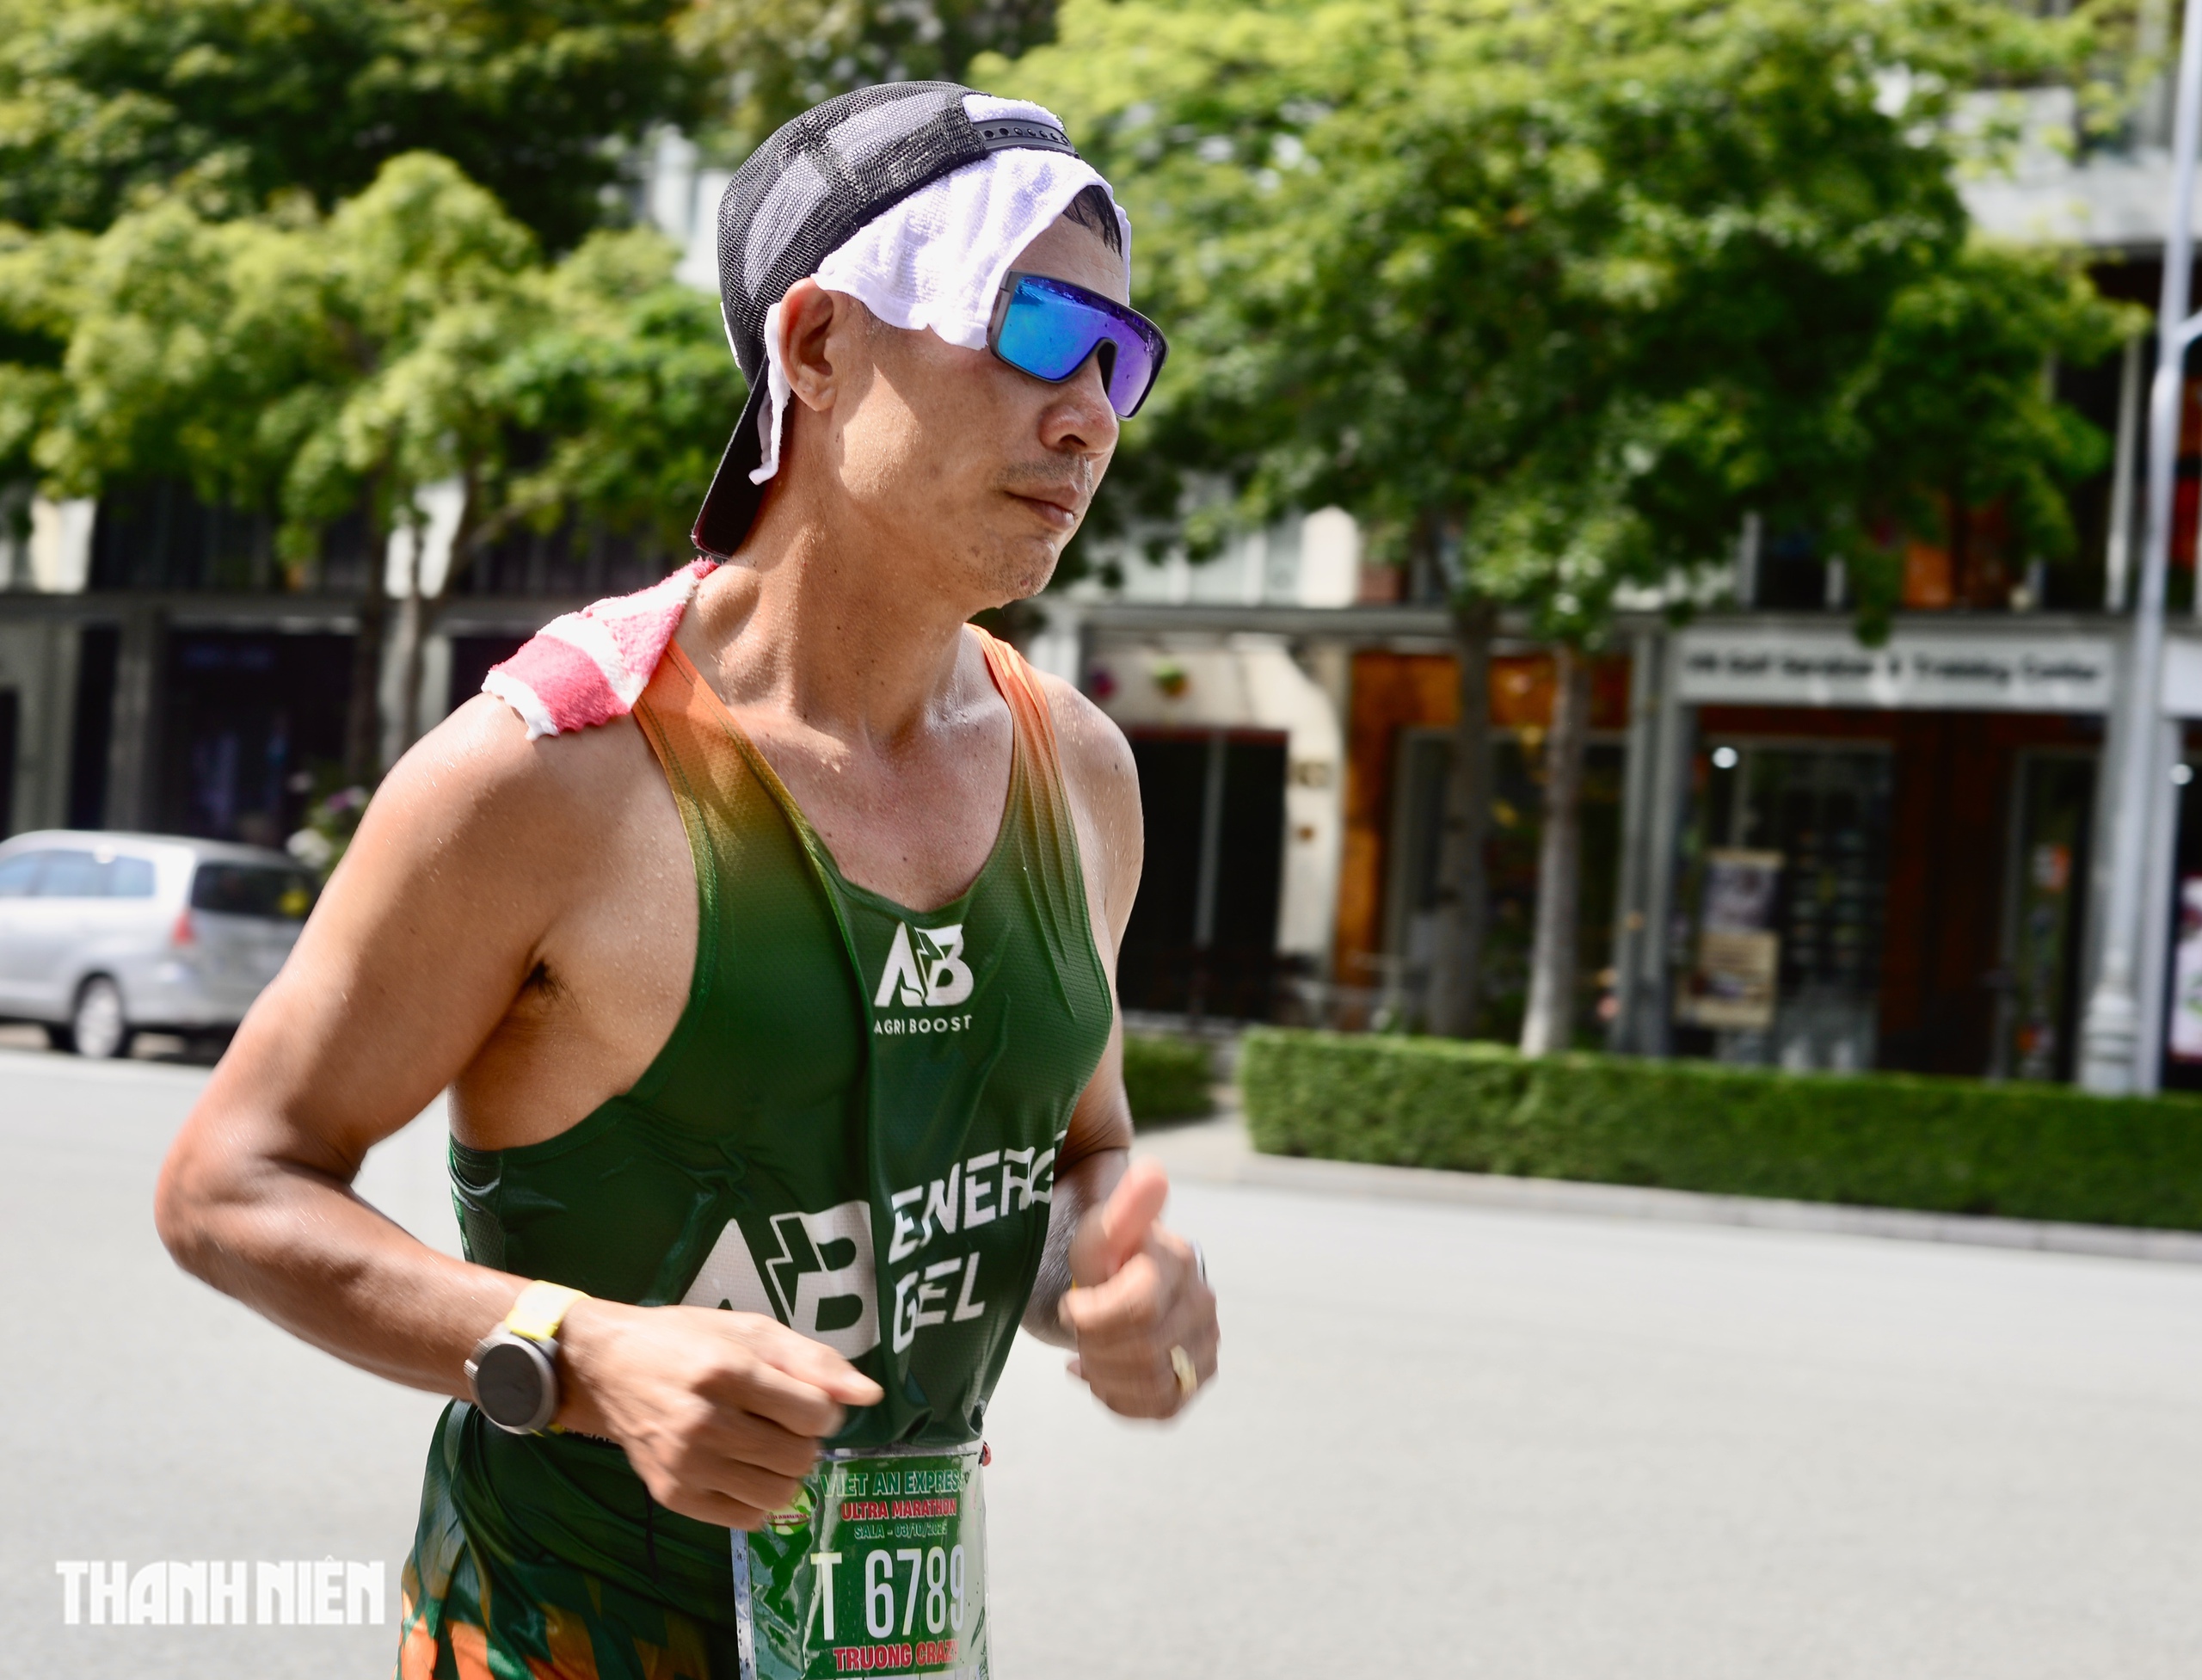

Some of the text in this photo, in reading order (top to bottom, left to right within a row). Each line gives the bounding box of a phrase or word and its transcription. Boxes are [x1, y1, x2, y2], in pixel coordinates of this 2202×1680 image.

[873, 920, 975, 1007] AB
[873, 1015, 973, 1035] AGRI BOOST
[888, 1129, 1067, 1265] ENERG
[892, 1251, 986, 1354] GEL
[819, 1473, 868, 1498] VIET
[872, 1471, 901, 1496] AN
[840, 1498, 957, 1521] ULTRA MARATHON
[854, 1523, 885, 1540] SALA
[810, 1544, 965, 1641] T 6789
[833, 1639, 959, 1671] TRUONG CRAZY
